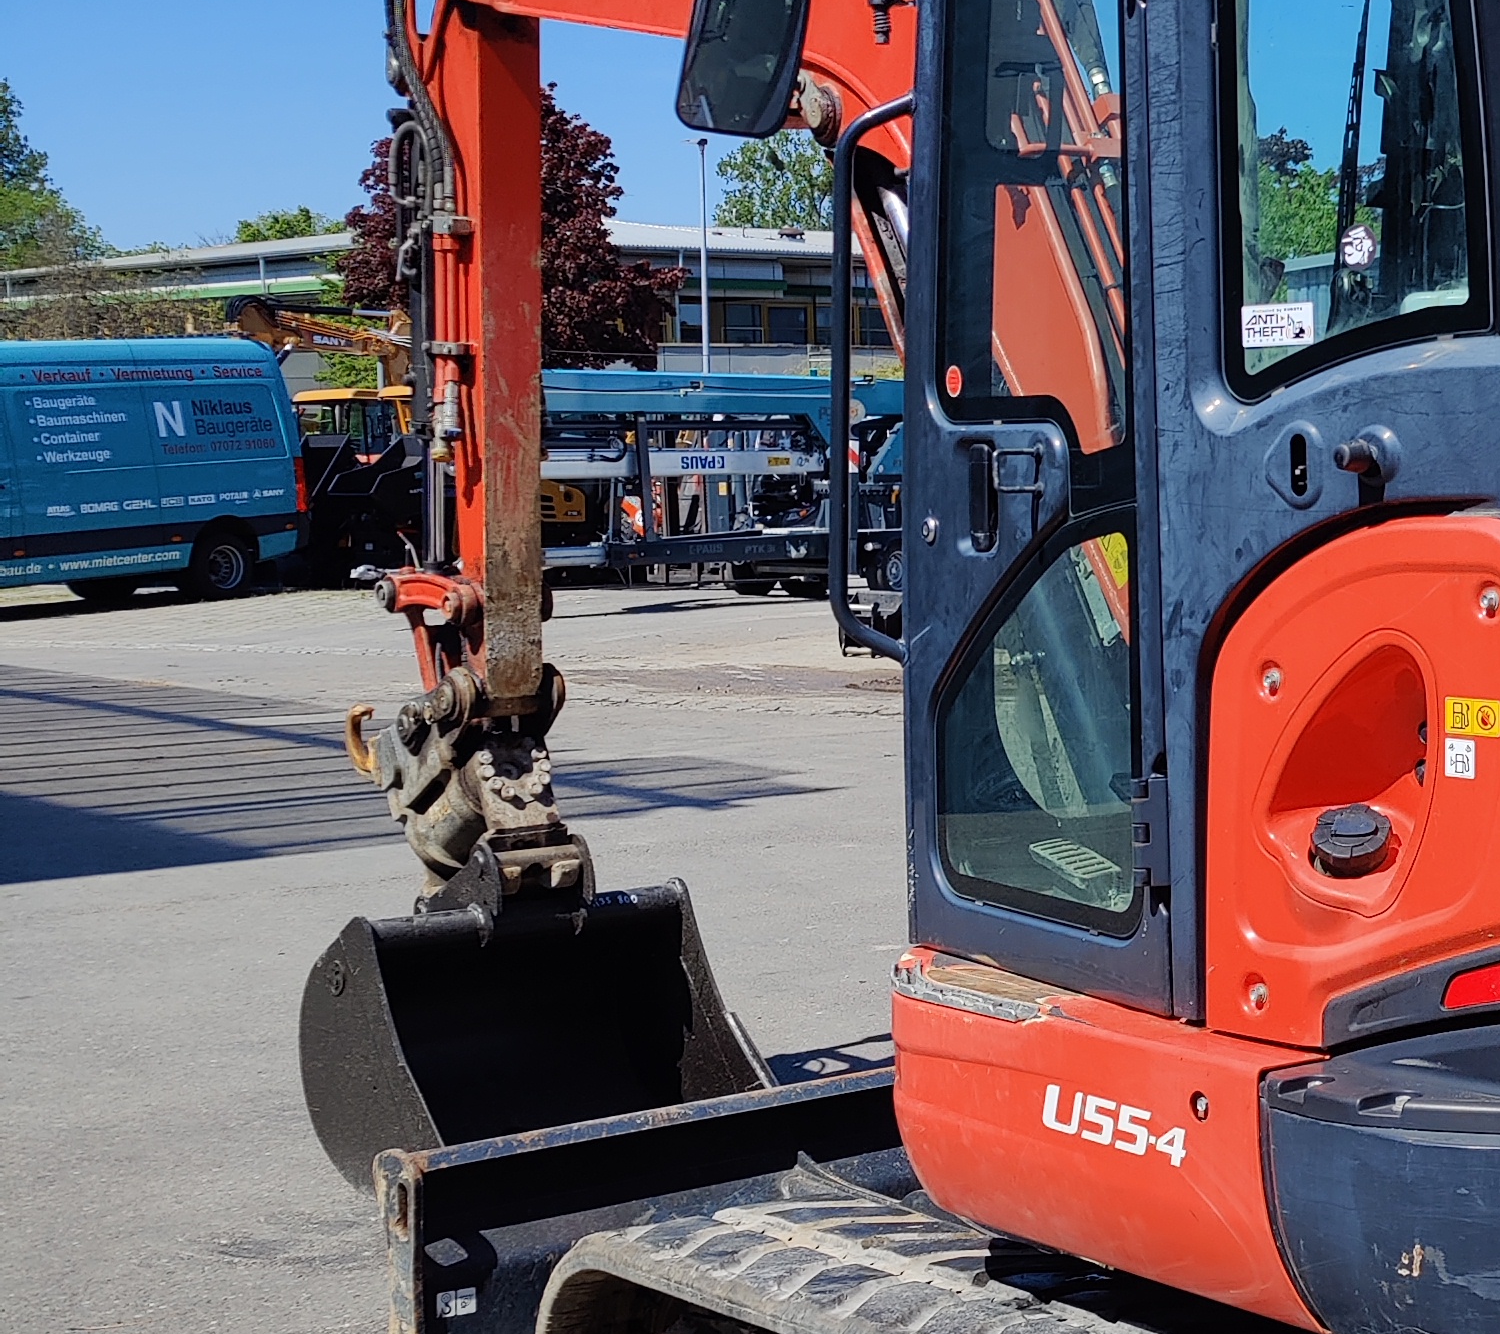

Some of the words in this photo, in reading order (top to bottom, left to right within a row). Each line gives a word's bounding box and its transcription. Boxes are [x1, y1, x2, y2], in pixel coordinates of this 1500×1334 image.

[312, 334, 347, 347] SANY
[1245, 326, 1285, 338] THEFT
[32, 368, 91, 383] Verkauf
[110, 367, 195, 382] Vermietung
[212, 365, 263, 378] Service
[32, 395, 97, 410] Baugeräte
[191, 399, 253, 417] Niklaus
[36, 411, 127, 427] Baumaschinen
[153, 400, 186, 438] N
[194, 417, 273, 438] Baugeräte
[40, 430, 101, 445] Container
[161, 443, 206, 455] Telefon:
[210, 440, 242, 452] 07072
[43, 449, 112, 464] Werkzeuge
[80, 501, 119, 514] BOMAG
[122, 499, 158, 511] GEHL
[188, 494, 216, 505] KATO
[219, 491, 249, 501] POTAIN
[59, 550, 181, 572] www.mietcenter.com
[1042, 1083, 1187, 1168] U55-4
